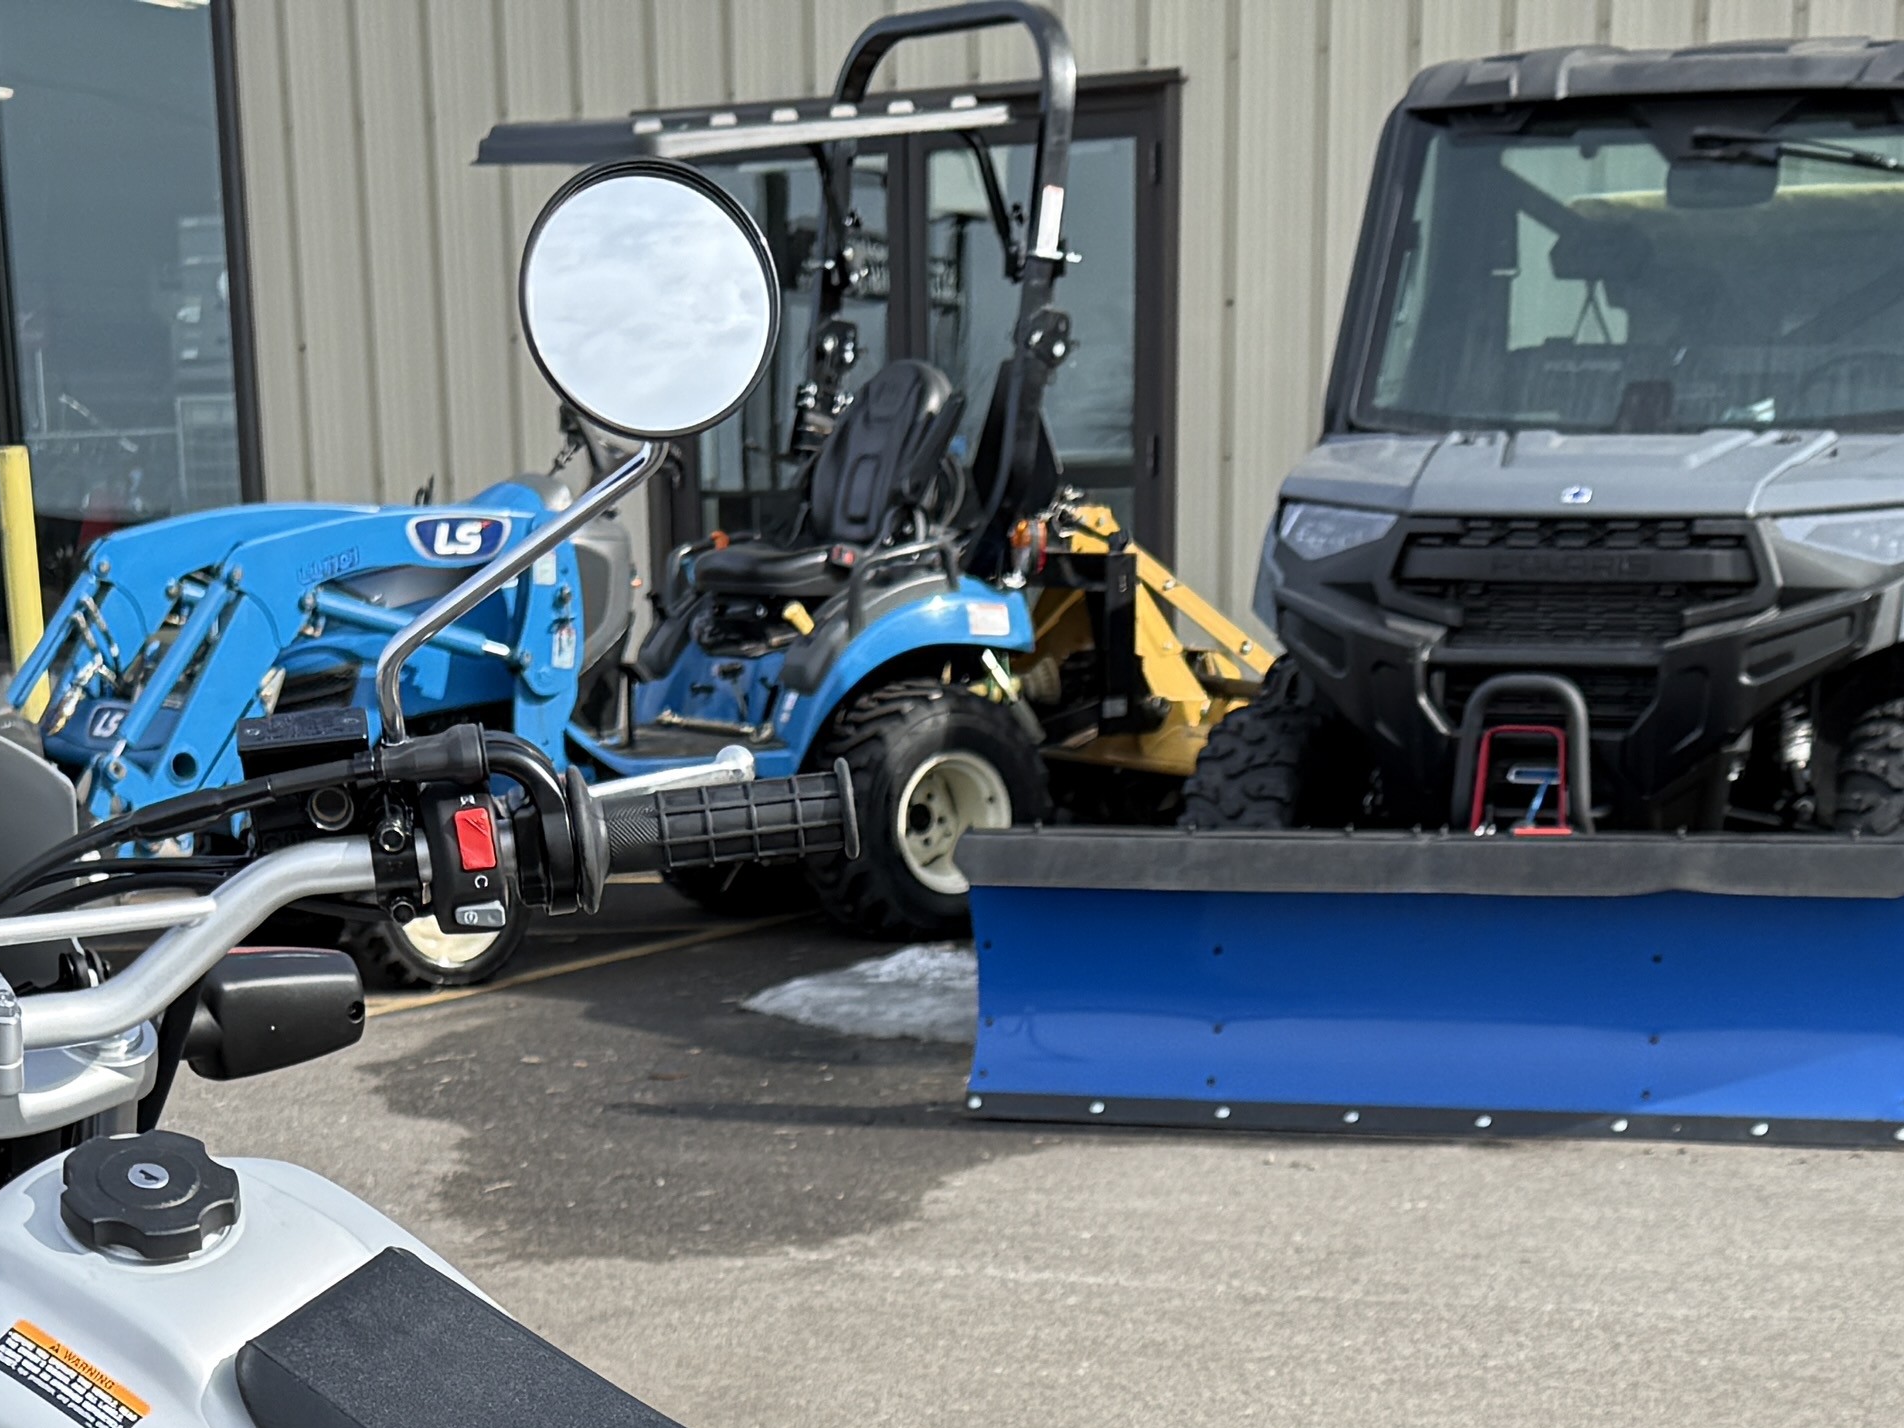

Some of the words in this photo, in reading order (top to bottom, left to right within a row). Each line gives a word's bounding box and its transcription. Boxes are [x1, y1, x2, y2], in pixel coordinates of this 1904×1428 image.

[434, 521, 483, 556] LS
[92, 710, 125, 738] LS
[63, 1350, 116, 1391] WARNING
